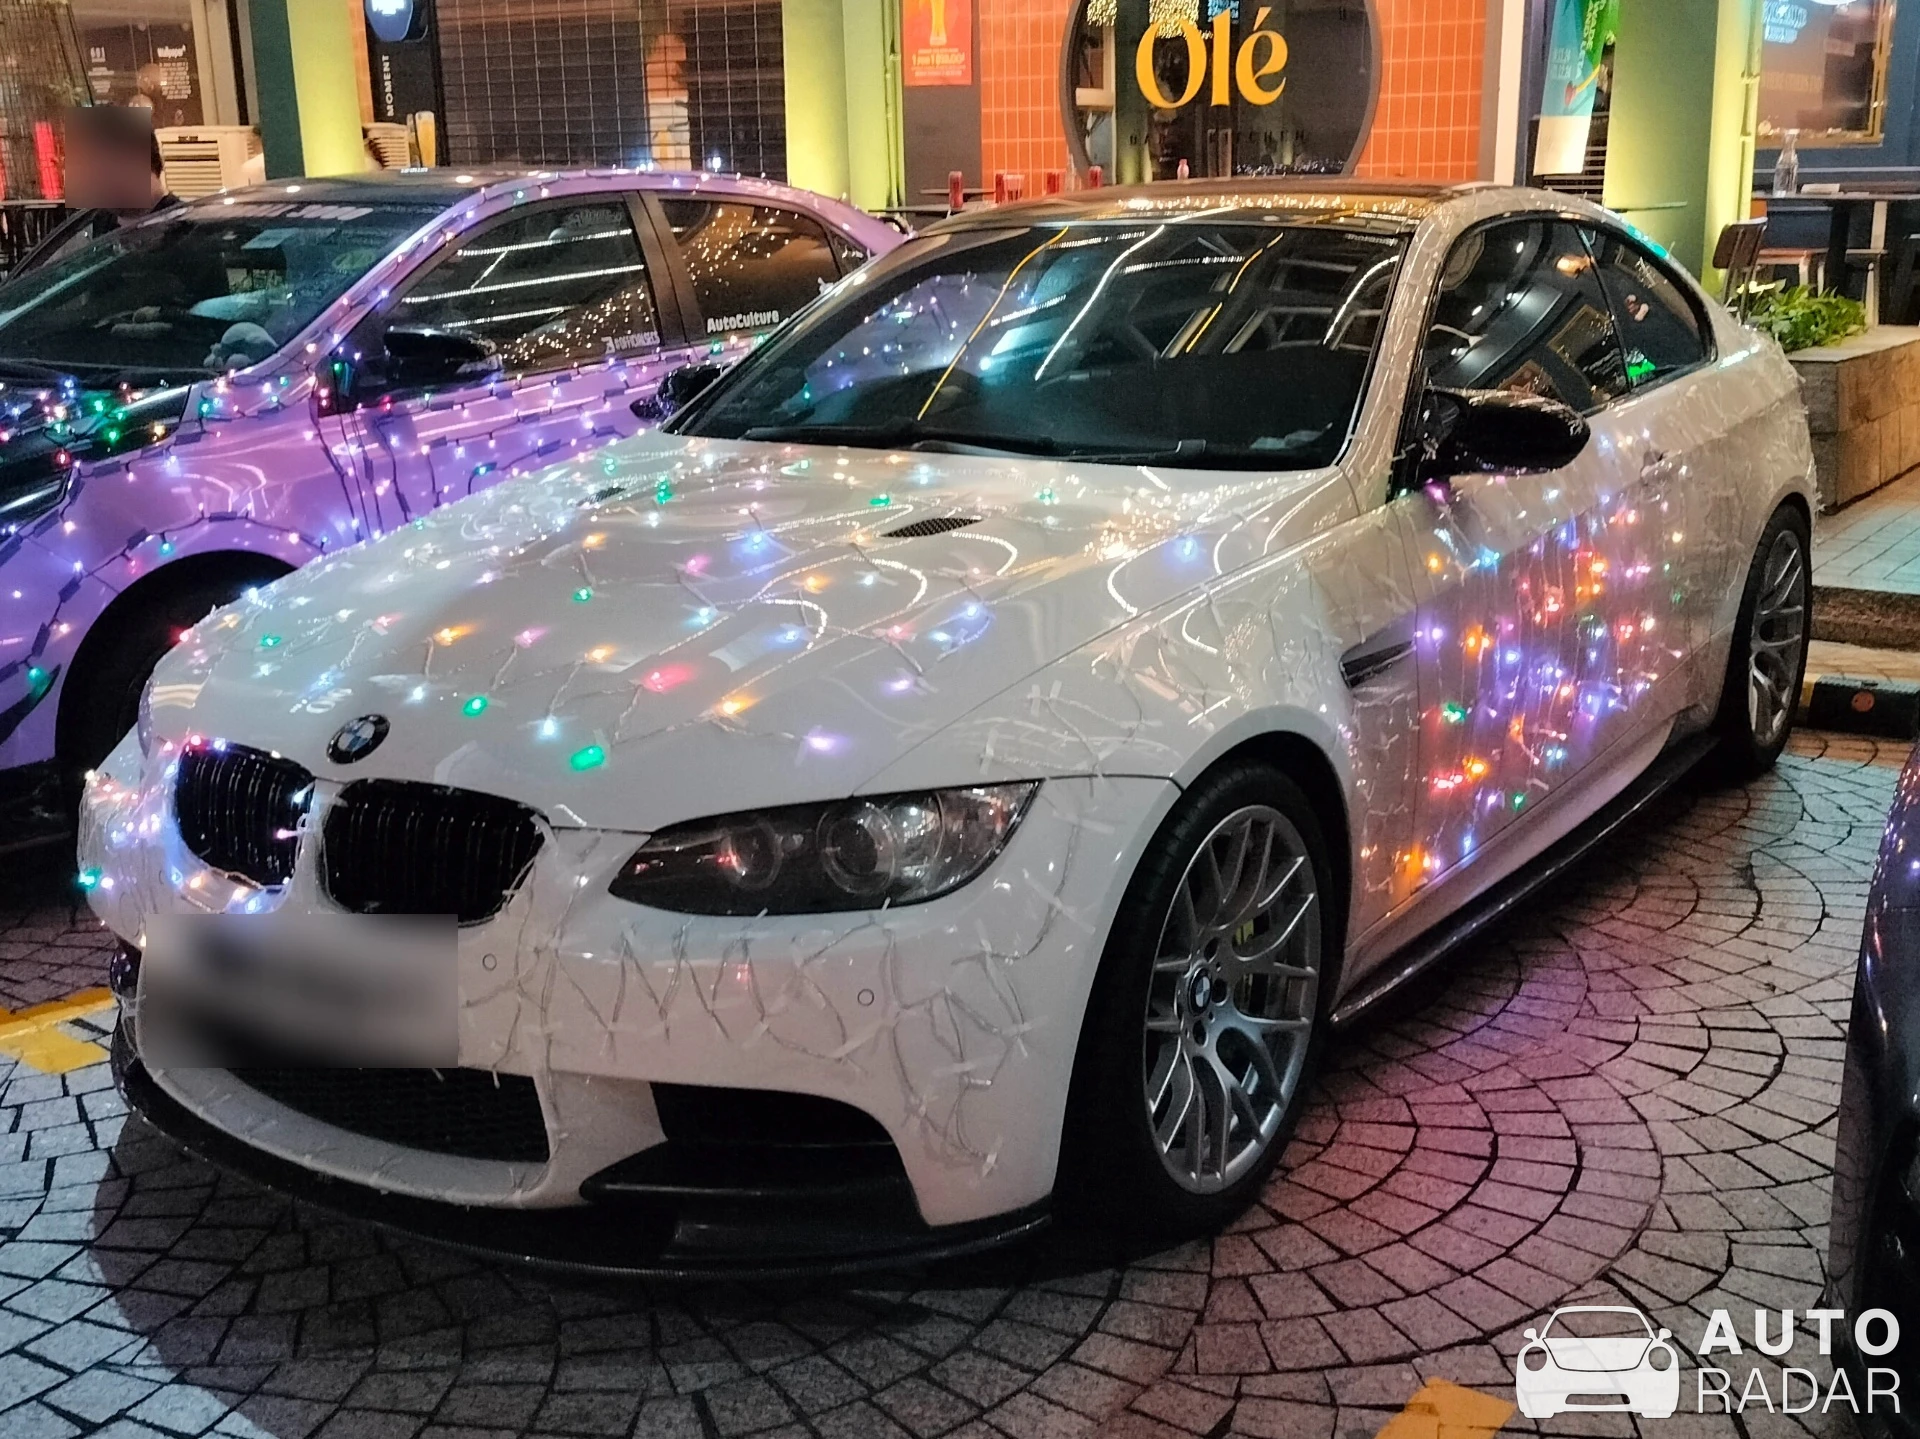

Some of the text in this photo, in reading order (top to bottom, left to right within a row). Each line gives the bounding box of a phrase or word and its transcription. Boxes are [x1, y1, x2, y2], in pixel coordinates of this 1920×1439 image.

[381, 54, 395, 117] MOMENT
[1135, 6, 1289, 109] Olé
[707, 310, 780, 334] AutoCulture
